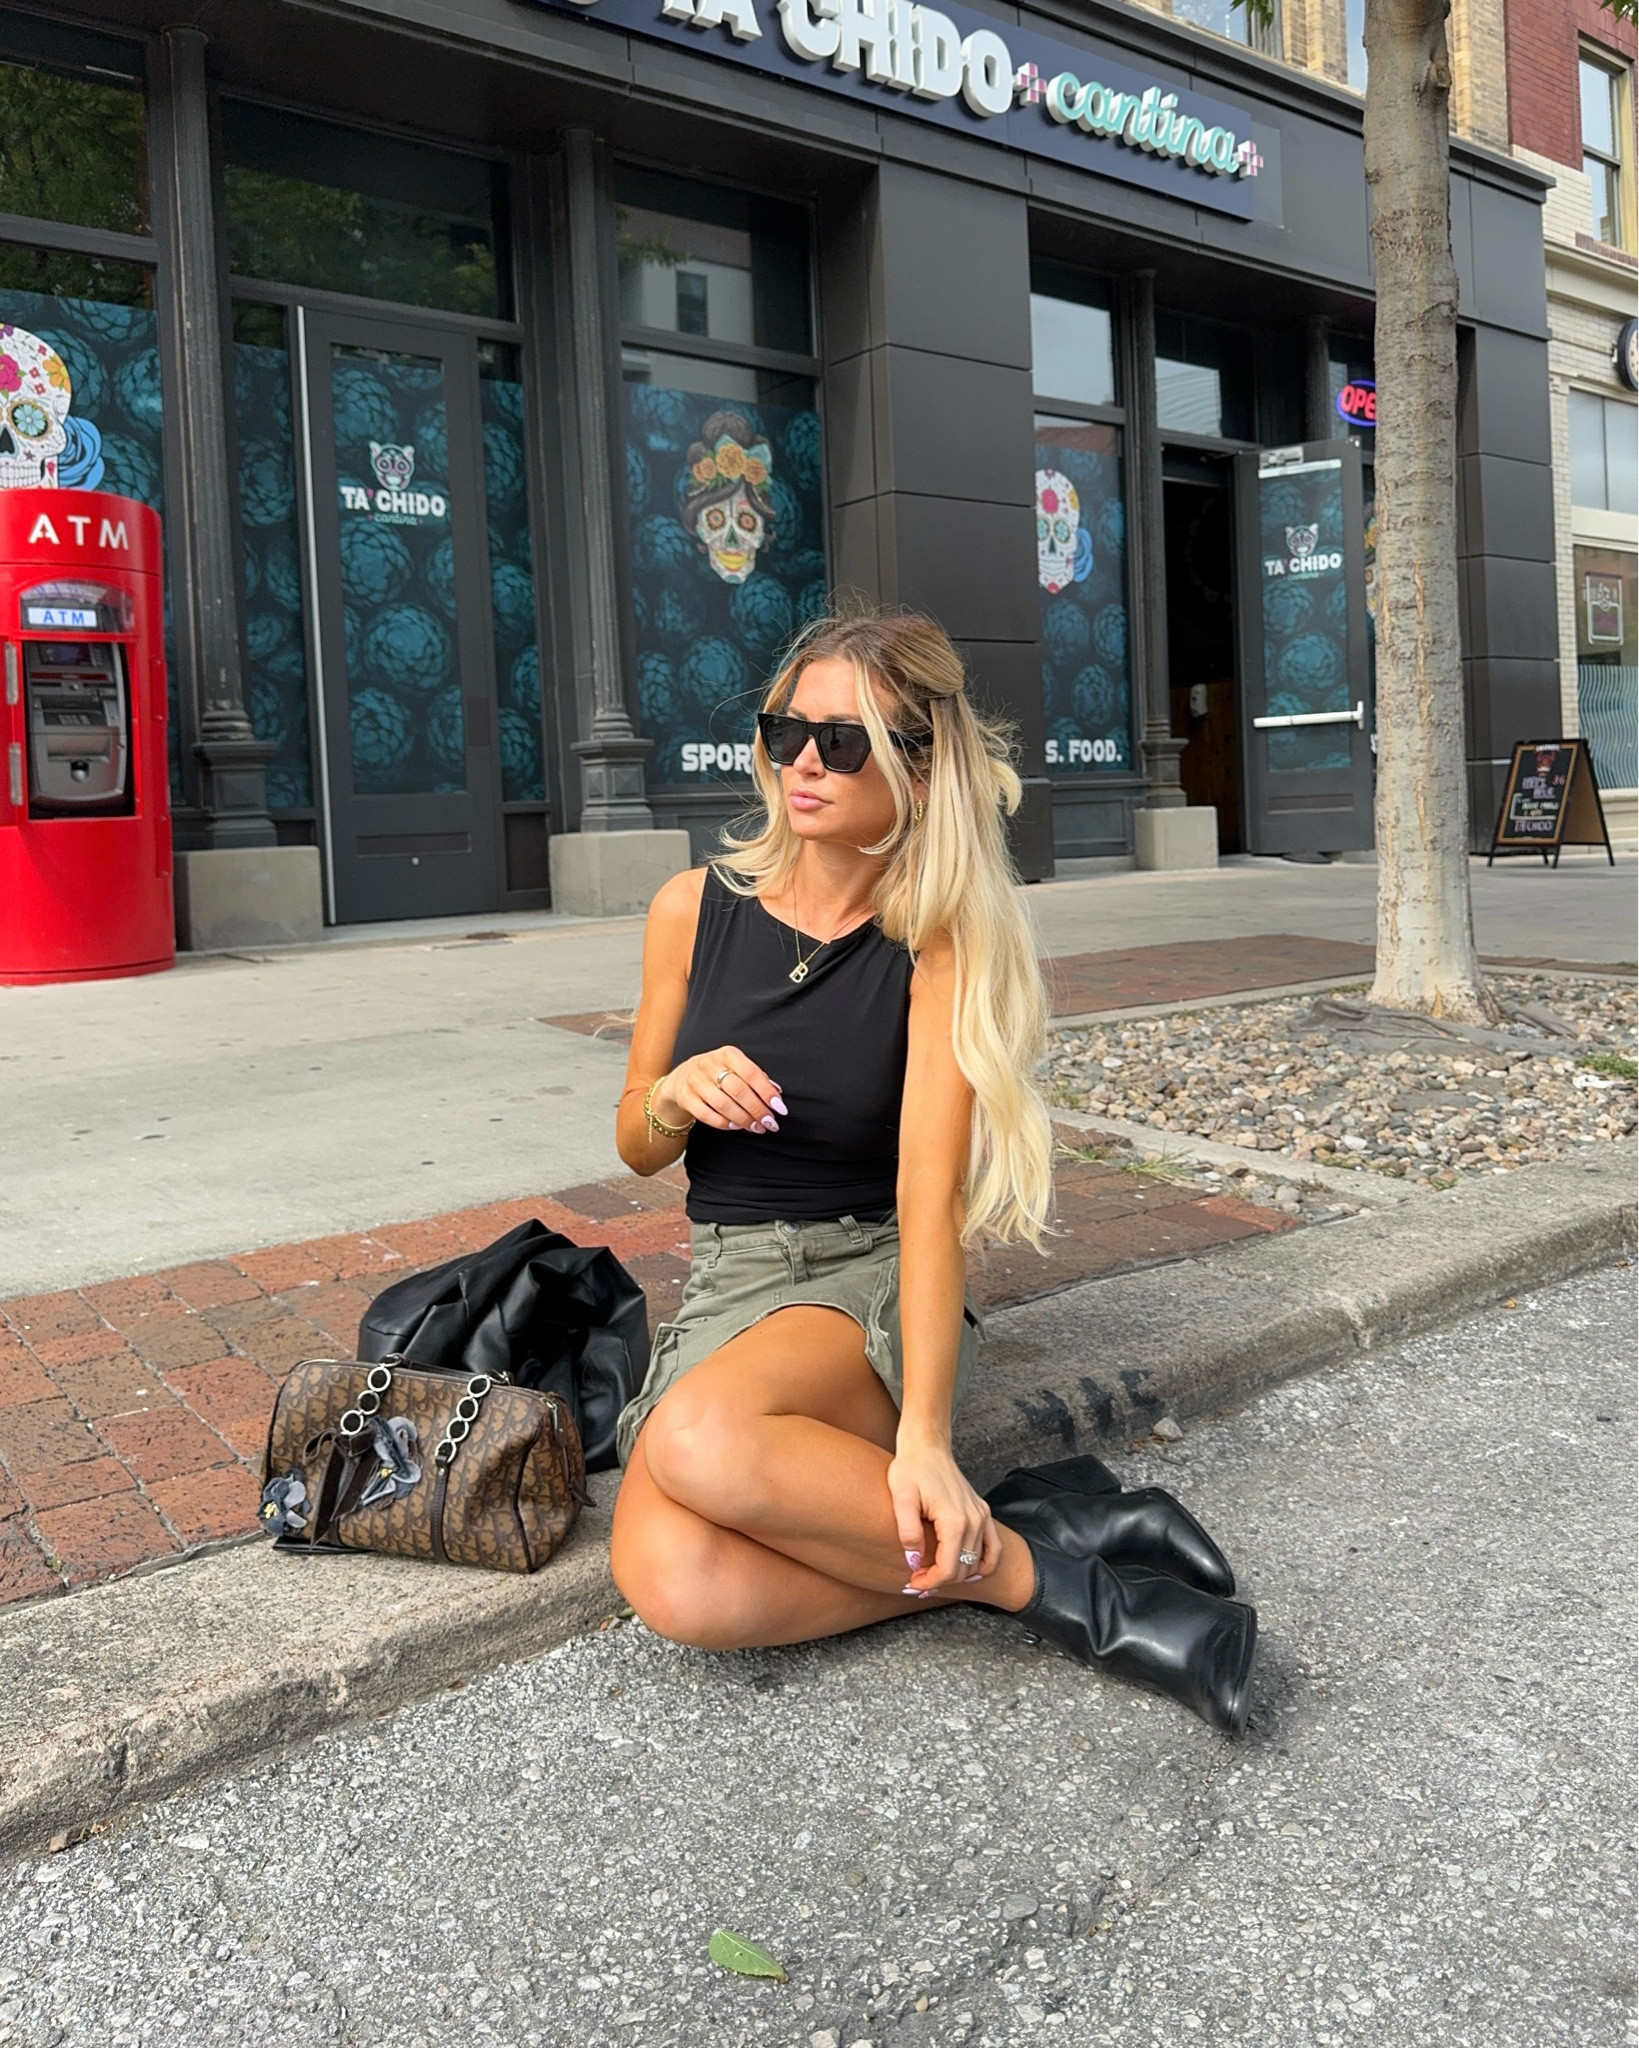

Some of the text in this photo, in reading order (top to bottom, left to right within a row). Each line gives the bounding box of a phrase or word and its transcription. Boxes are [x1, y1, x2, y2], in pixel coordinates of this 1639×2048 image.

[778, 0, 1240, 174] CHIDO cantina
[1340, 384, 1376, 420] OPE
[375, 489, 446, 517] CHIDO
[28, 513, 129, 551] ATM
[1289, 552, 1342, 573] CHIDO
[43, 610, 85, 625] ATM
[681, 743, 755, 775] SPOR
[1068, 739, 1122, 763] FOOD.
